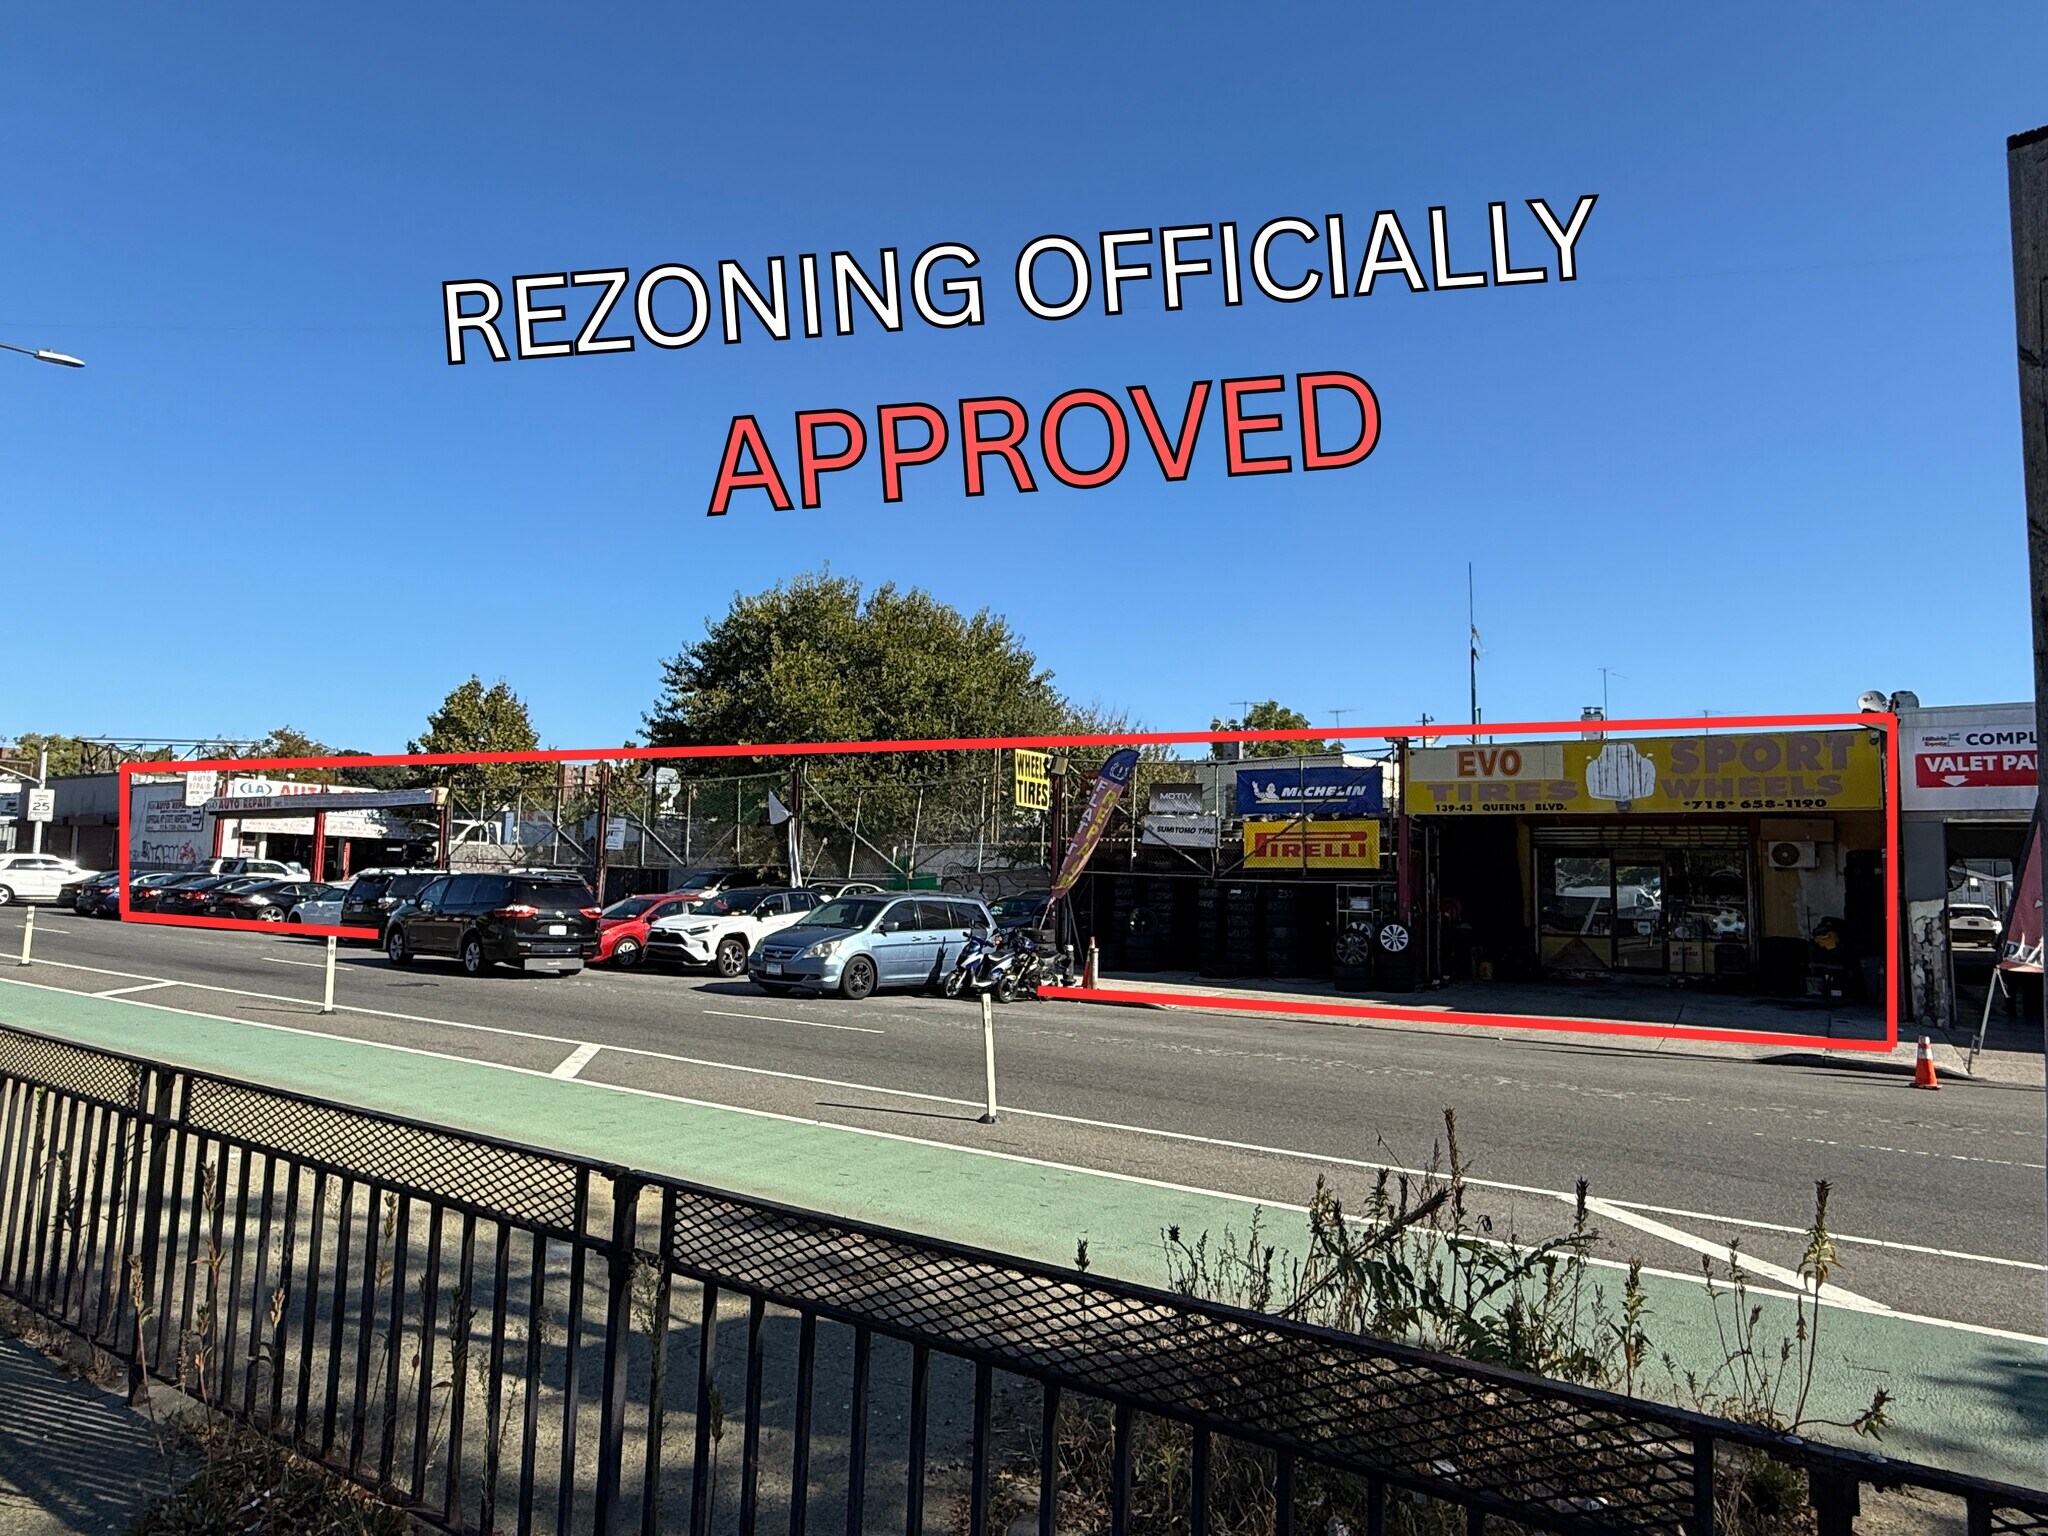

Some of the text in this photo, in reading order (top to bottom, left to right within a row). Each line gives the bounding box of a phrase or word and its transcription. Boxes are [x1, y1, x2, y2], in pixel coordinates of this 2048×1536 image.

[1457, 748, 1522, 778] EVO
[1670, 733, 1855, 774] SPORT
[1016, 752, 1051, 779] WHEELS
[1924, 755, 2038, 773] VALET PA
[248, 783, 265, 794] LA
[1017, 780, 1049, 807] TIRES
[1160, 792, 1193, 800] MOTIV
[1426, 781, 1579, 802] TIRES
[1660, 774, 1844, 799] WHEELS
[32, 802, 50, 812] 25
[218, 799, 240, 809] AUTO
[243, 798, 272, 809] REPAIR
[1077, 779, 1109, 834] FLAT
[1435, 803, 1567, 812] 139-43 QUEENS BLVD.
[1740, 799, 1828, 809] 658-1190
[1156, 825, 1197, 834] SUMITOMO
[1254, 832, 1367, 858] PIRELLI
